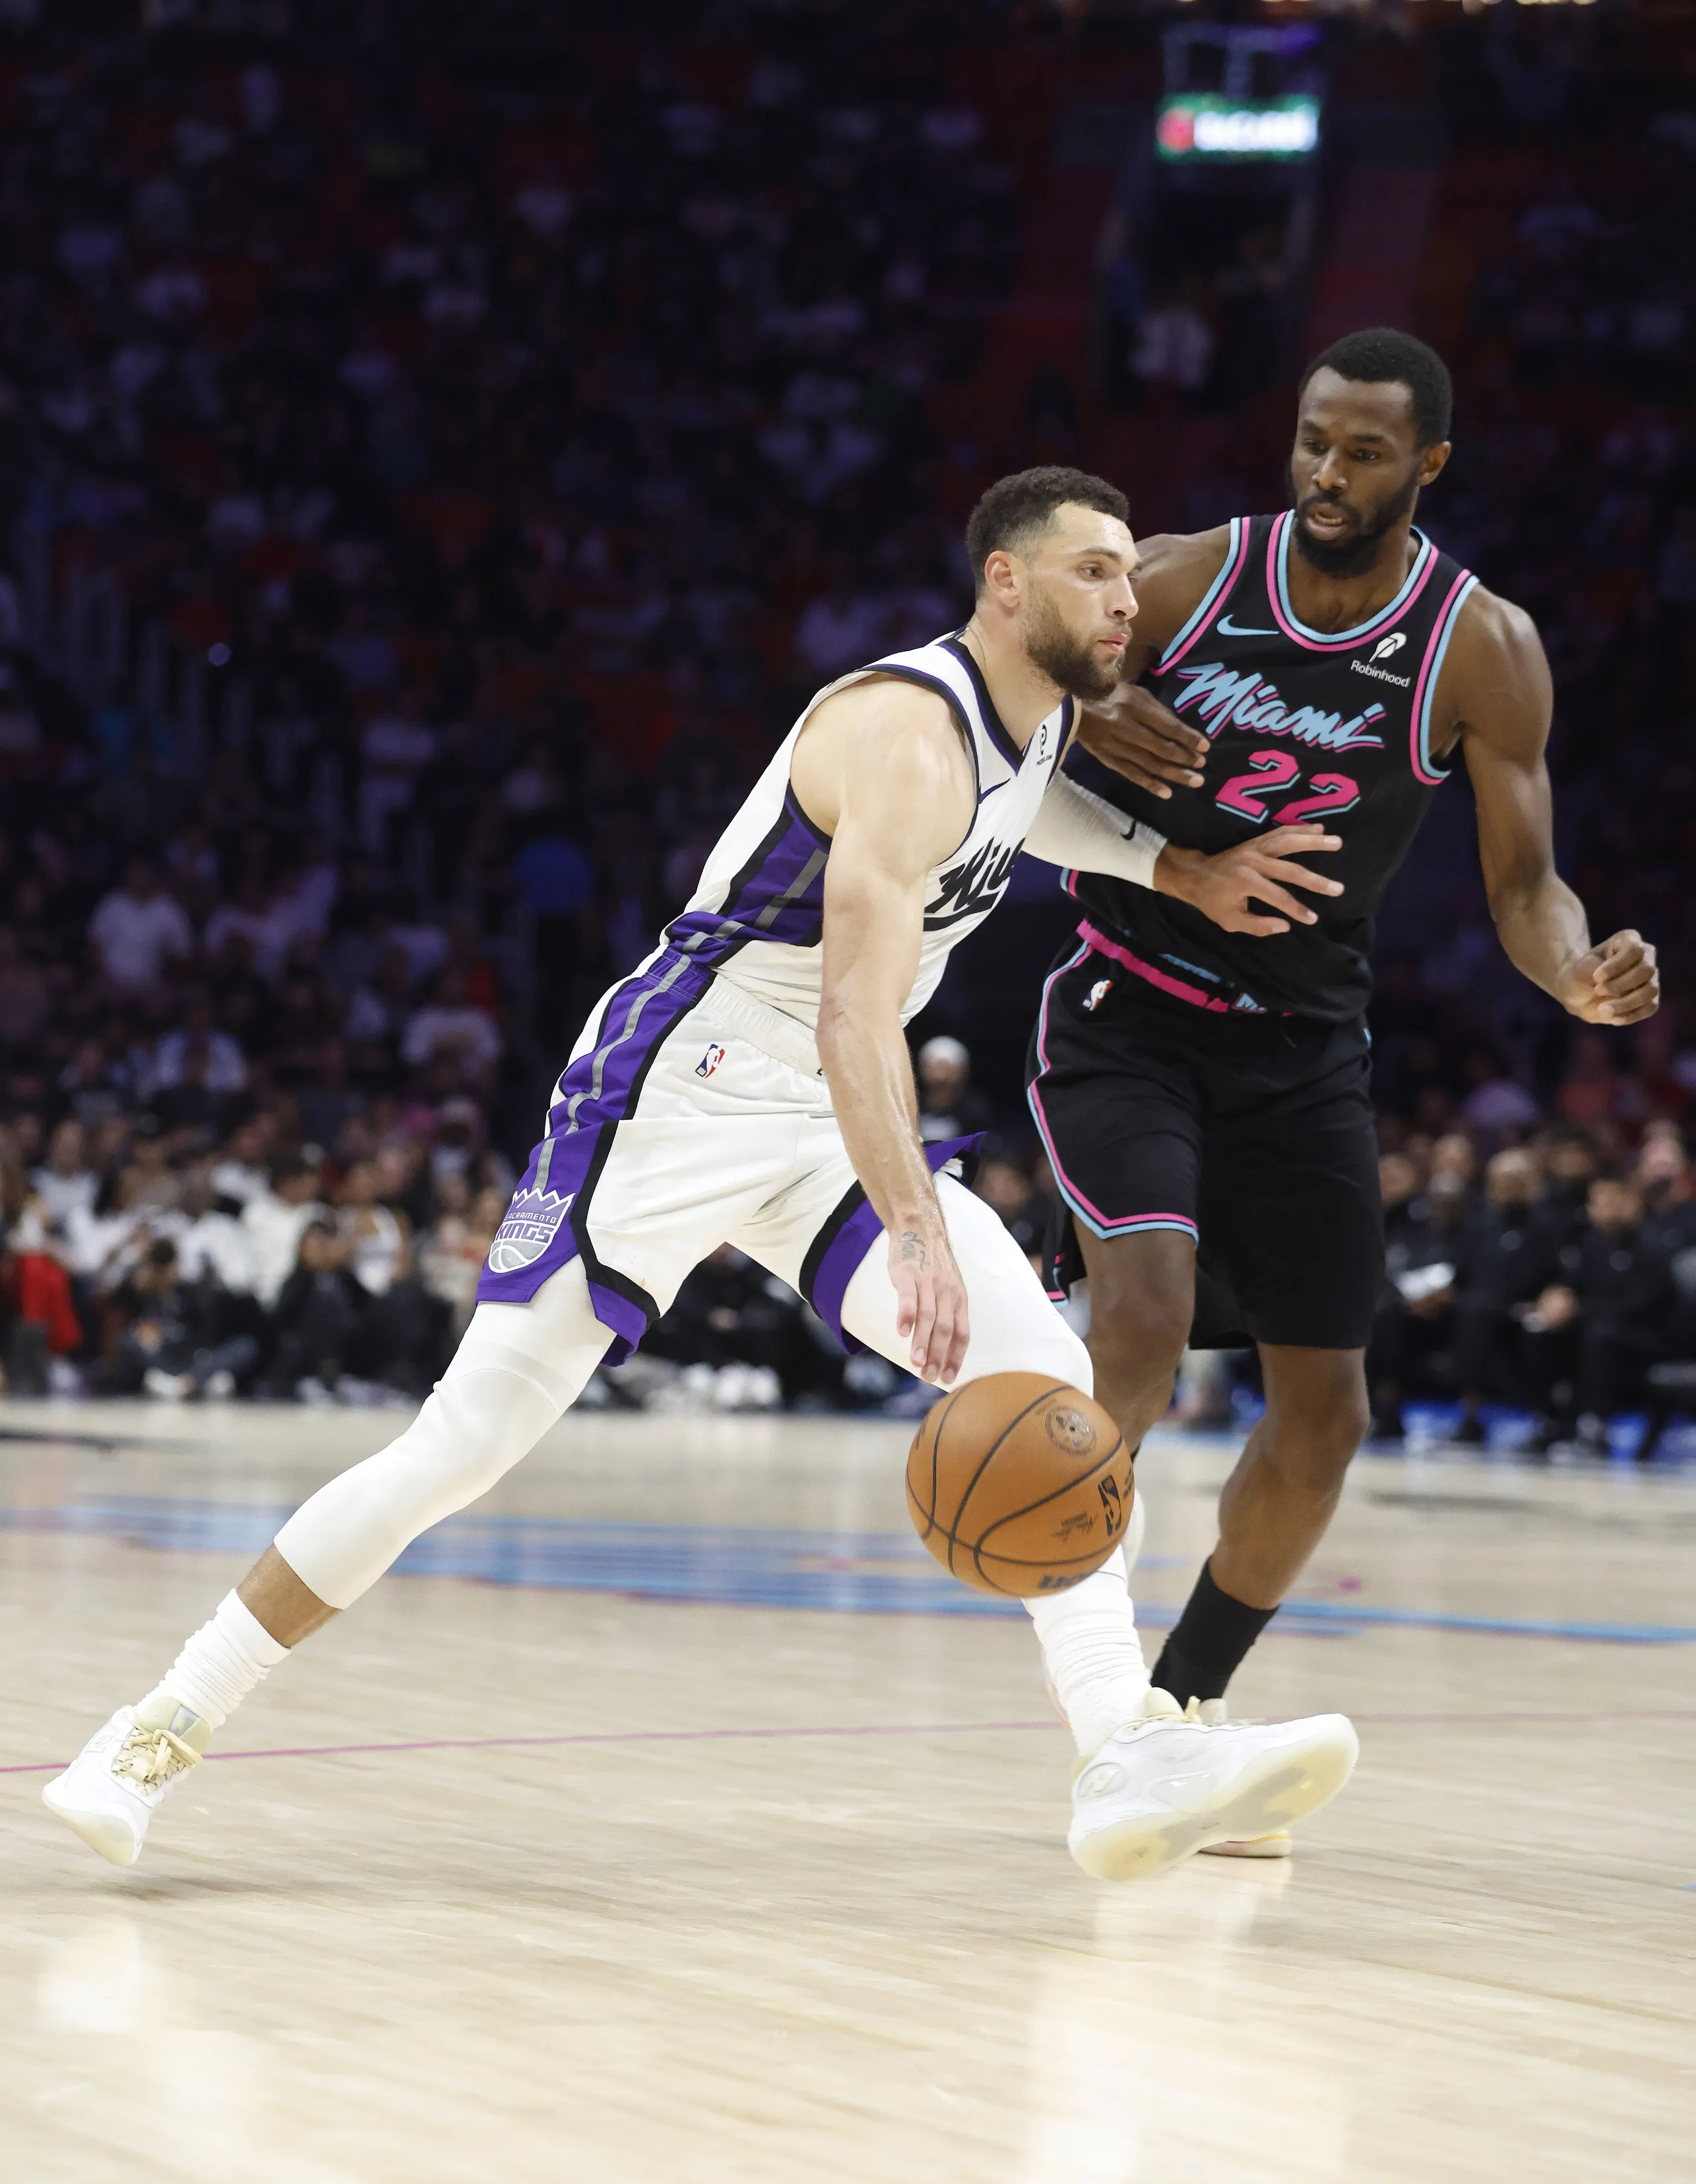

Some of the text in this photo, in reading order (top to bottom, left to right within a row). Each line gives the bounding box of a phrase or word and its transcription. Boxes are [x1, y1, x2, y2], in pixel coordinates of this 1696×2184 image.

[1350, 660, 1411, 687] Robinhood
[1174, 662, 1386, 753] Miami
[1214, 749, 1361, 826] 22
[496, 1223, 554, 1243] KINGS
